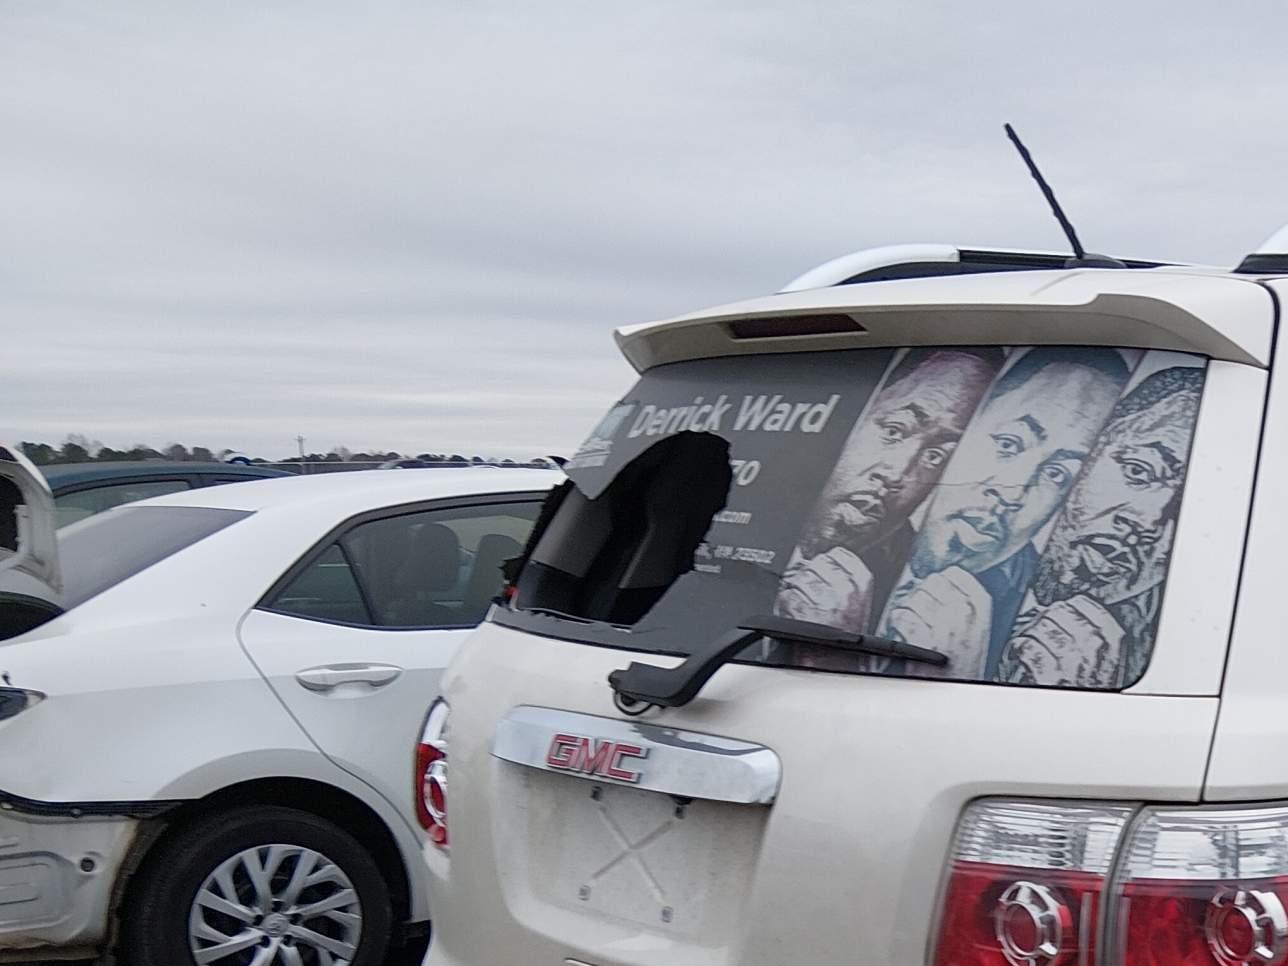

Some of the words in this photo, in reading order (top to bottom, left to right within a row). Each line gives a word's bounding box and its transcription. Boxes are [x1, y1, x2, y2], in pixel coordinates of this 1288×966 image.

[627, 395, 732, 438] Derrick
[733, 394, 840, 432] Ward
[545, 732, 651, 784] GMC
